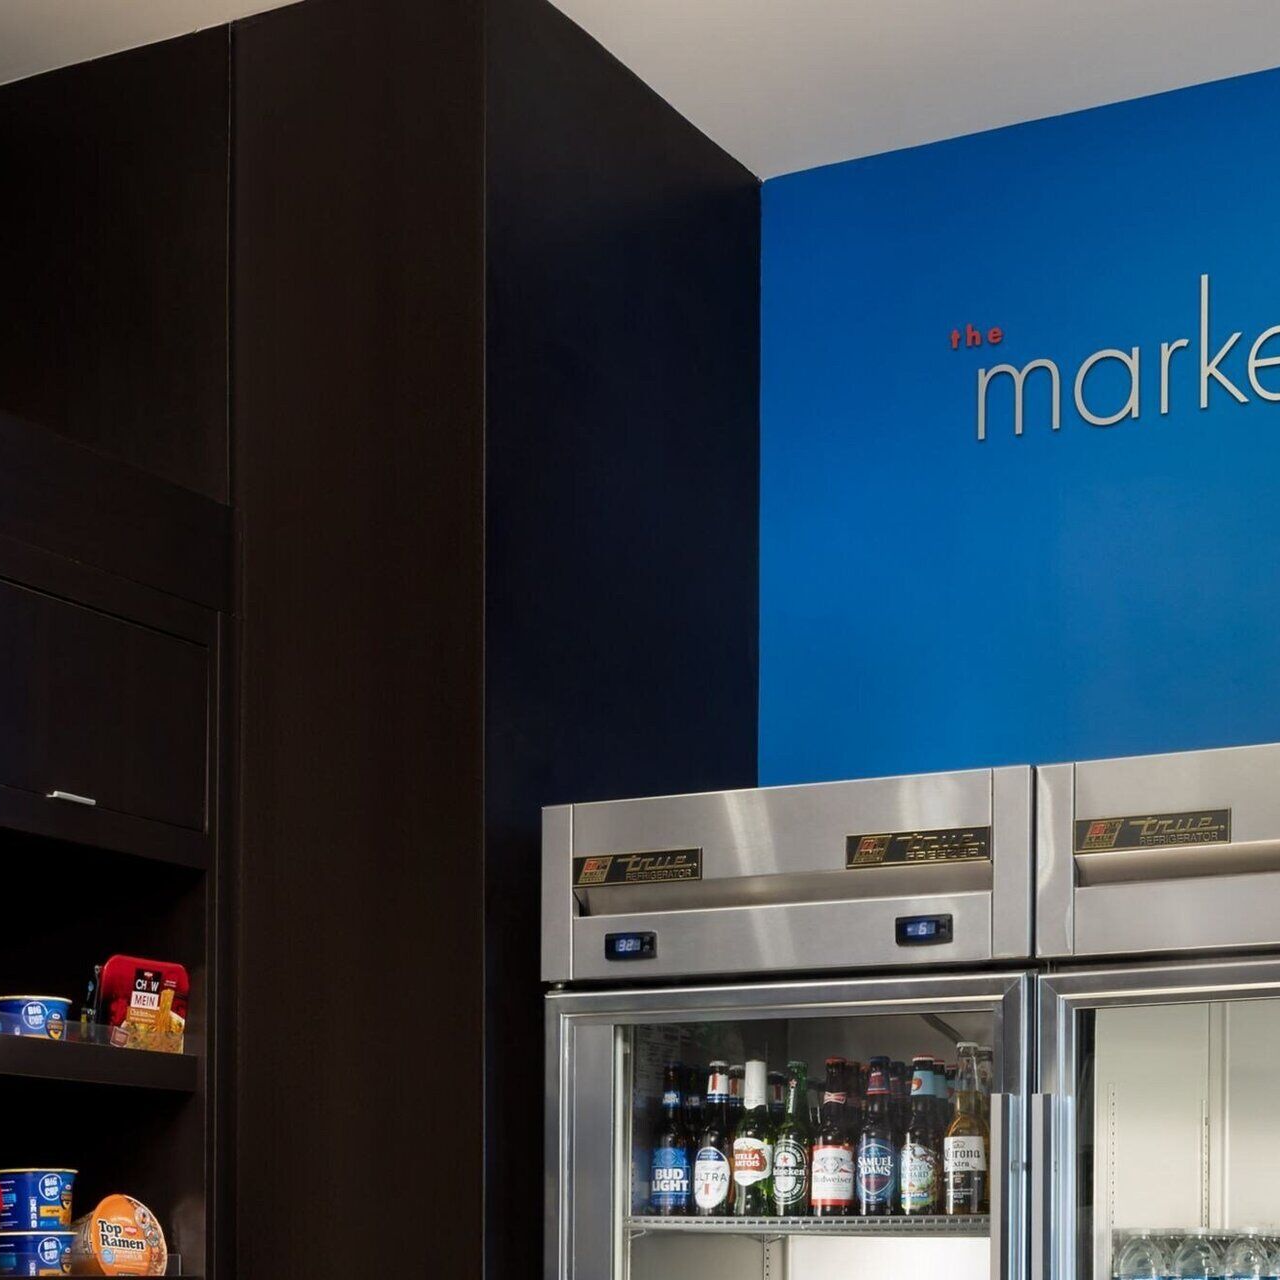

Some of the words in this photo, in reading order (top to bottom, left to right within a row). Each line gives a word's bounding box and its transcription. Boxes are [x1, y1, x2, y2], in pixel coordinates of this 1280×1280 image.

[949, 324, 1004, 349] the
[1139, 832, 1218, 846] REFRIGERATOR
[625, 868, 692, 881] REFRIGERATOR
[134, 995, 155, 1007] MEIN
[28, 1005, 41, 1015] BIG
[858, 1156, 893, 1168] SAMUEL
[655, 1168, 683, 1179] BUD
[696, 1172, 727, 1182] LTRA
[45, 1177, 57, 1186] BIG
[652, 1180, 688, 1192] LIGHT
[98, 1220, 121, 1237] Top
[101, 1234, 145, 1250] Ramen
